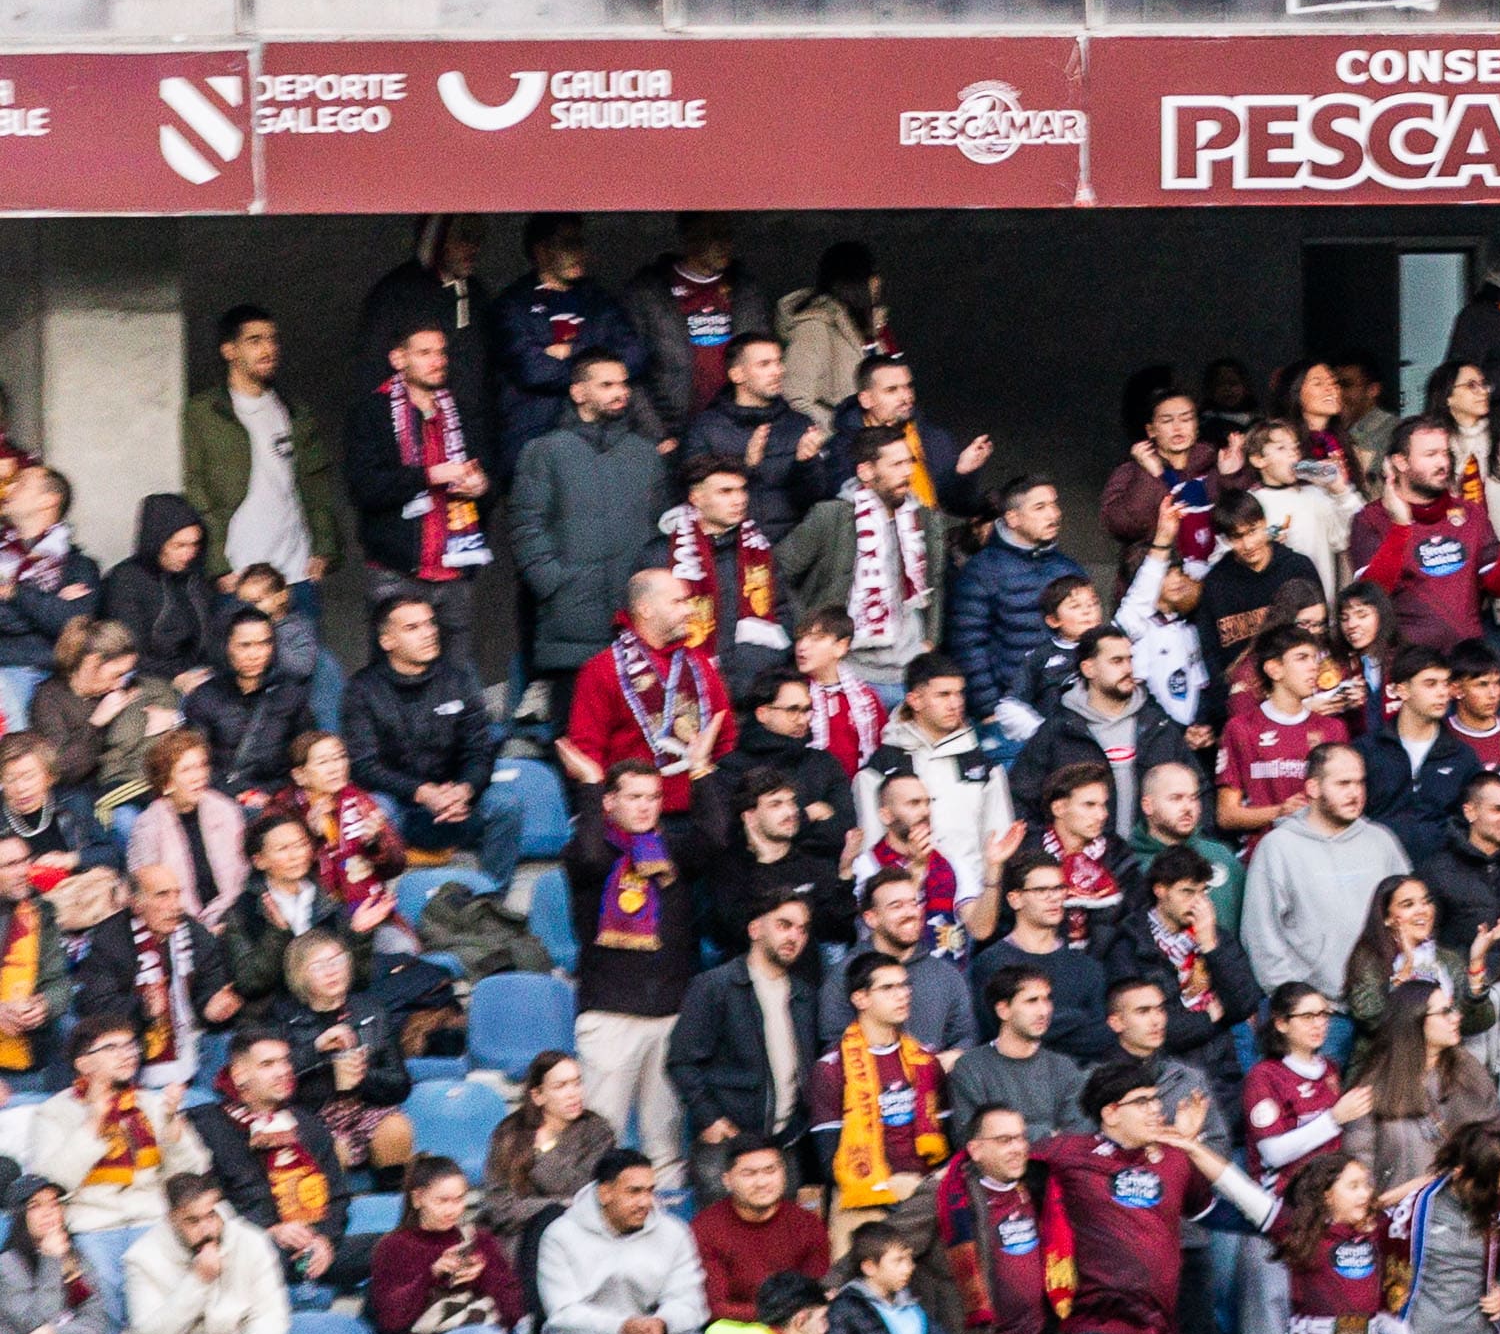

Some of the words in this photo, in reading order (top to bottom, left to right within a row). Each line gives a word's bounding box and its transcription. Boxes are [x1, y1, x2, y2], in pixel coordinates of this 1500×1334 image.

[550, 69, 672, 99] GALICIA
[255, 105, 392, 135] GALEGO
[550, 99, 707, 130] SAUDABLE
[899, 110, 1087, 146] PESCAMAR
